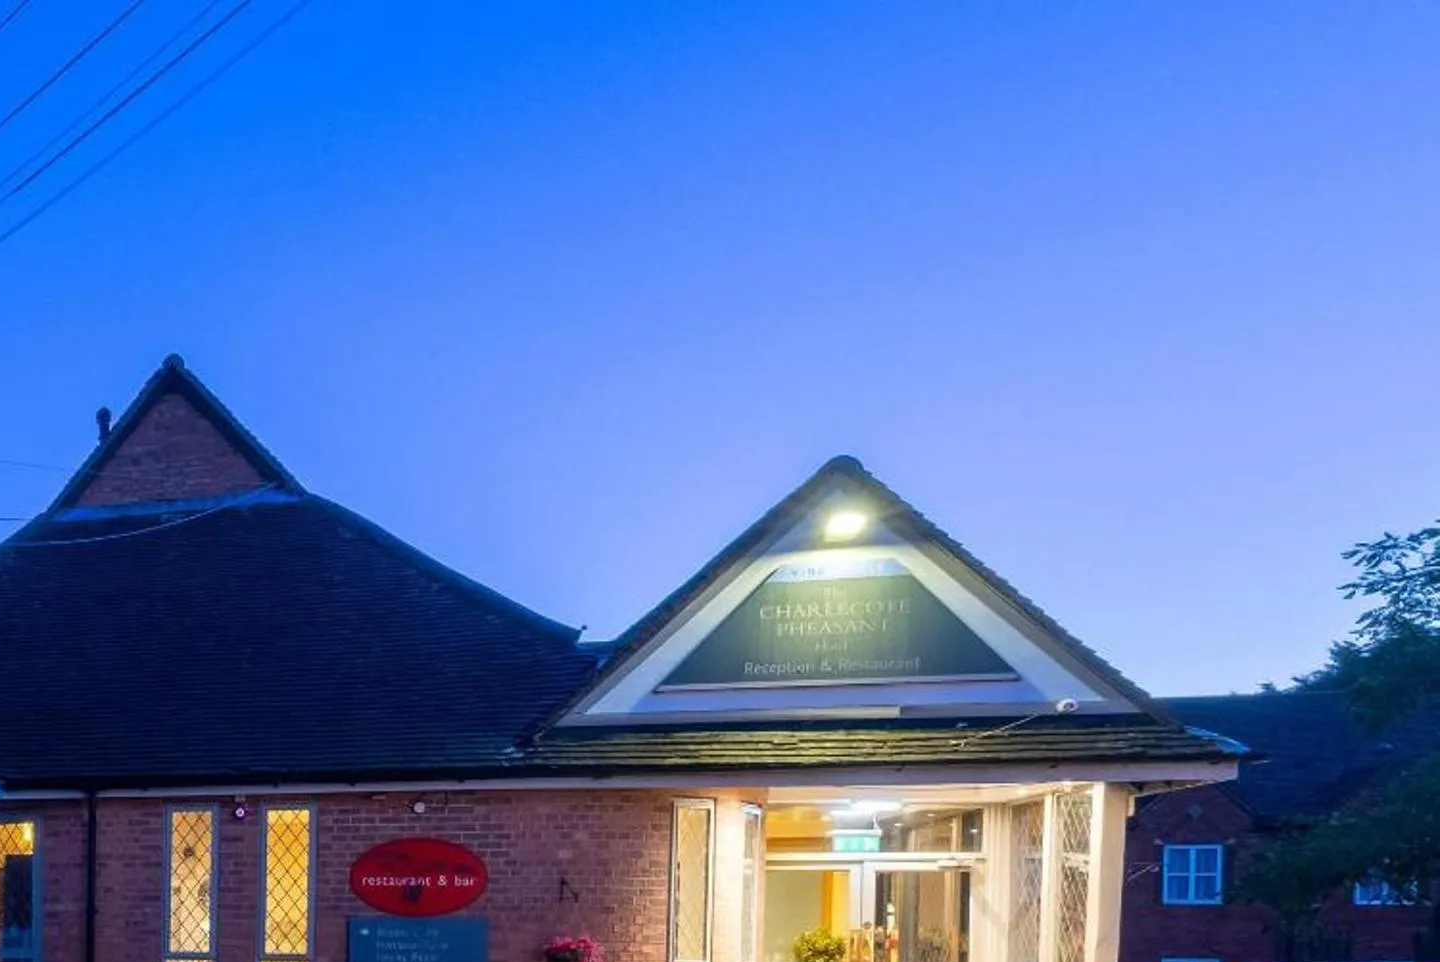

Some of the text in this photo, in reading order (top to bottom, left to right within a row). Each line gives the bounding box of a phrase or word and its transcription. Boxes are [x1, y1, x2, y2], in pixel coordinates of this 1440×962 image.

[760, 599, 911, 620] CHARLECOTE
[776, 618, 888, 637] PHEASANT
[744, 661, 815, 676] Reception
[838, 656, 921, 672] Restaurant
[362, 875, 477, 887] restaurant & bar
